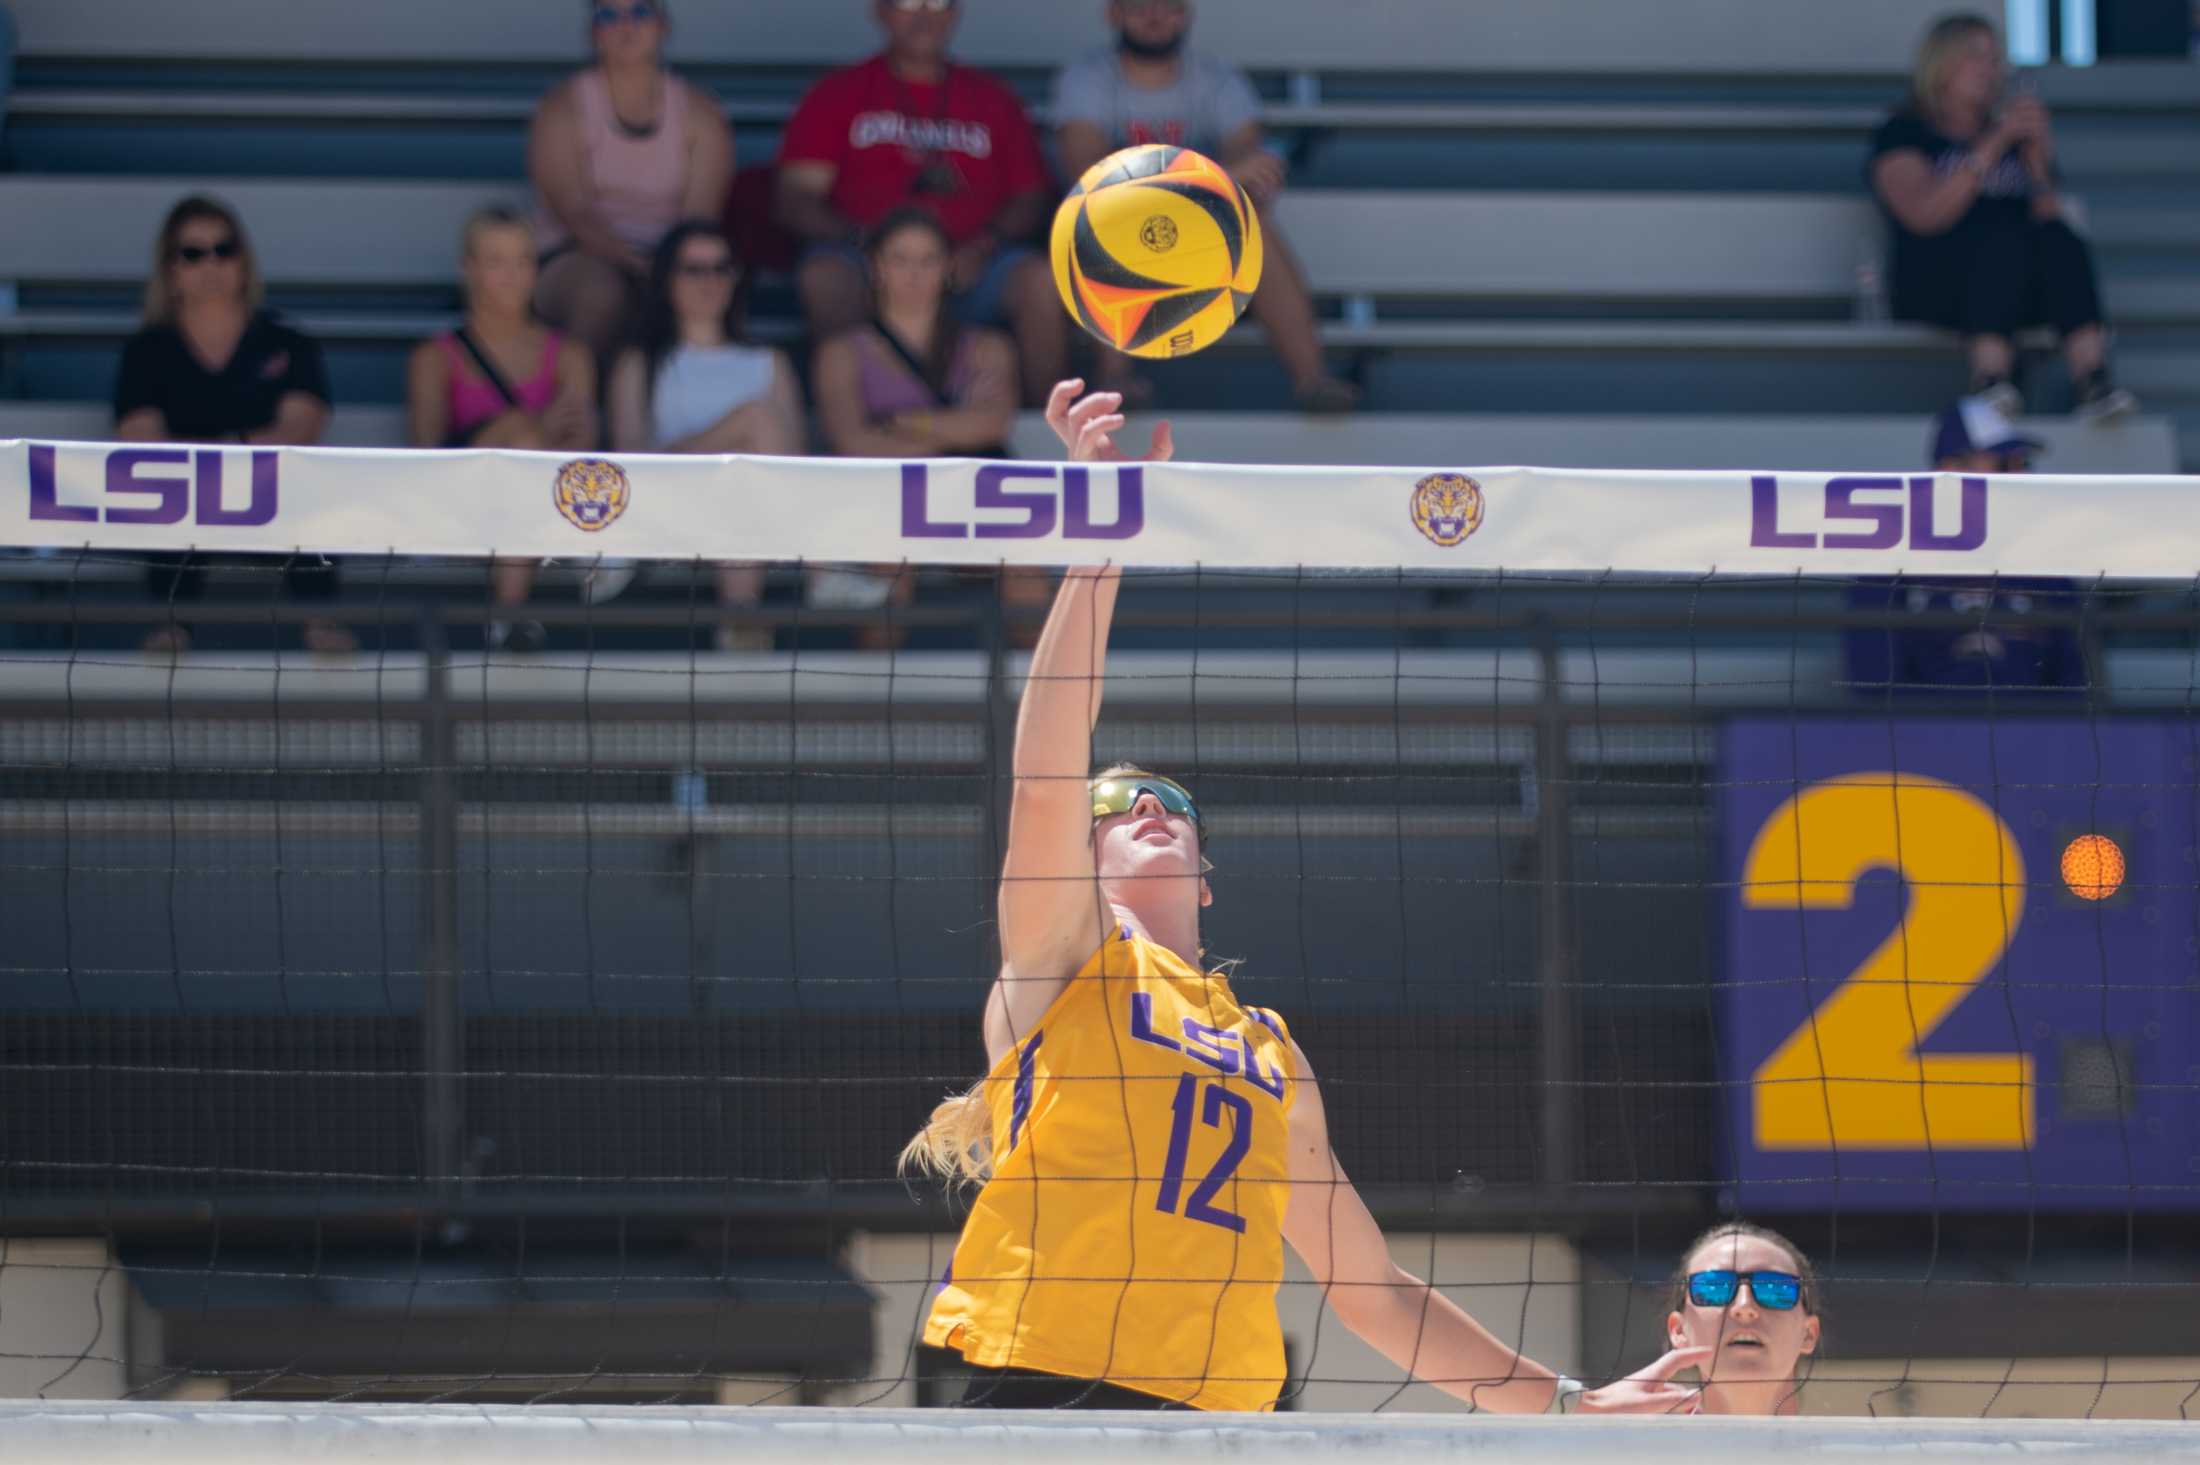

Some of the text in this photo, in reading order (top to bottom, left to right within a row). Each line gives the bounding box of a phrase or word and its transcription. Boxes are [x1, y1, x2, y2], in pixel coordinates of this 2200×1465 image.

[28, 444, 278, 526] LSU
[901, 463, 1144, 540] LSU
[1750, 476, 1988, 551] LSU
[1740, 771, 2036, 1151] 2
[1131, 992, 1284, 1102] LSU
[1155, 1071, 1253, 1234] 12
